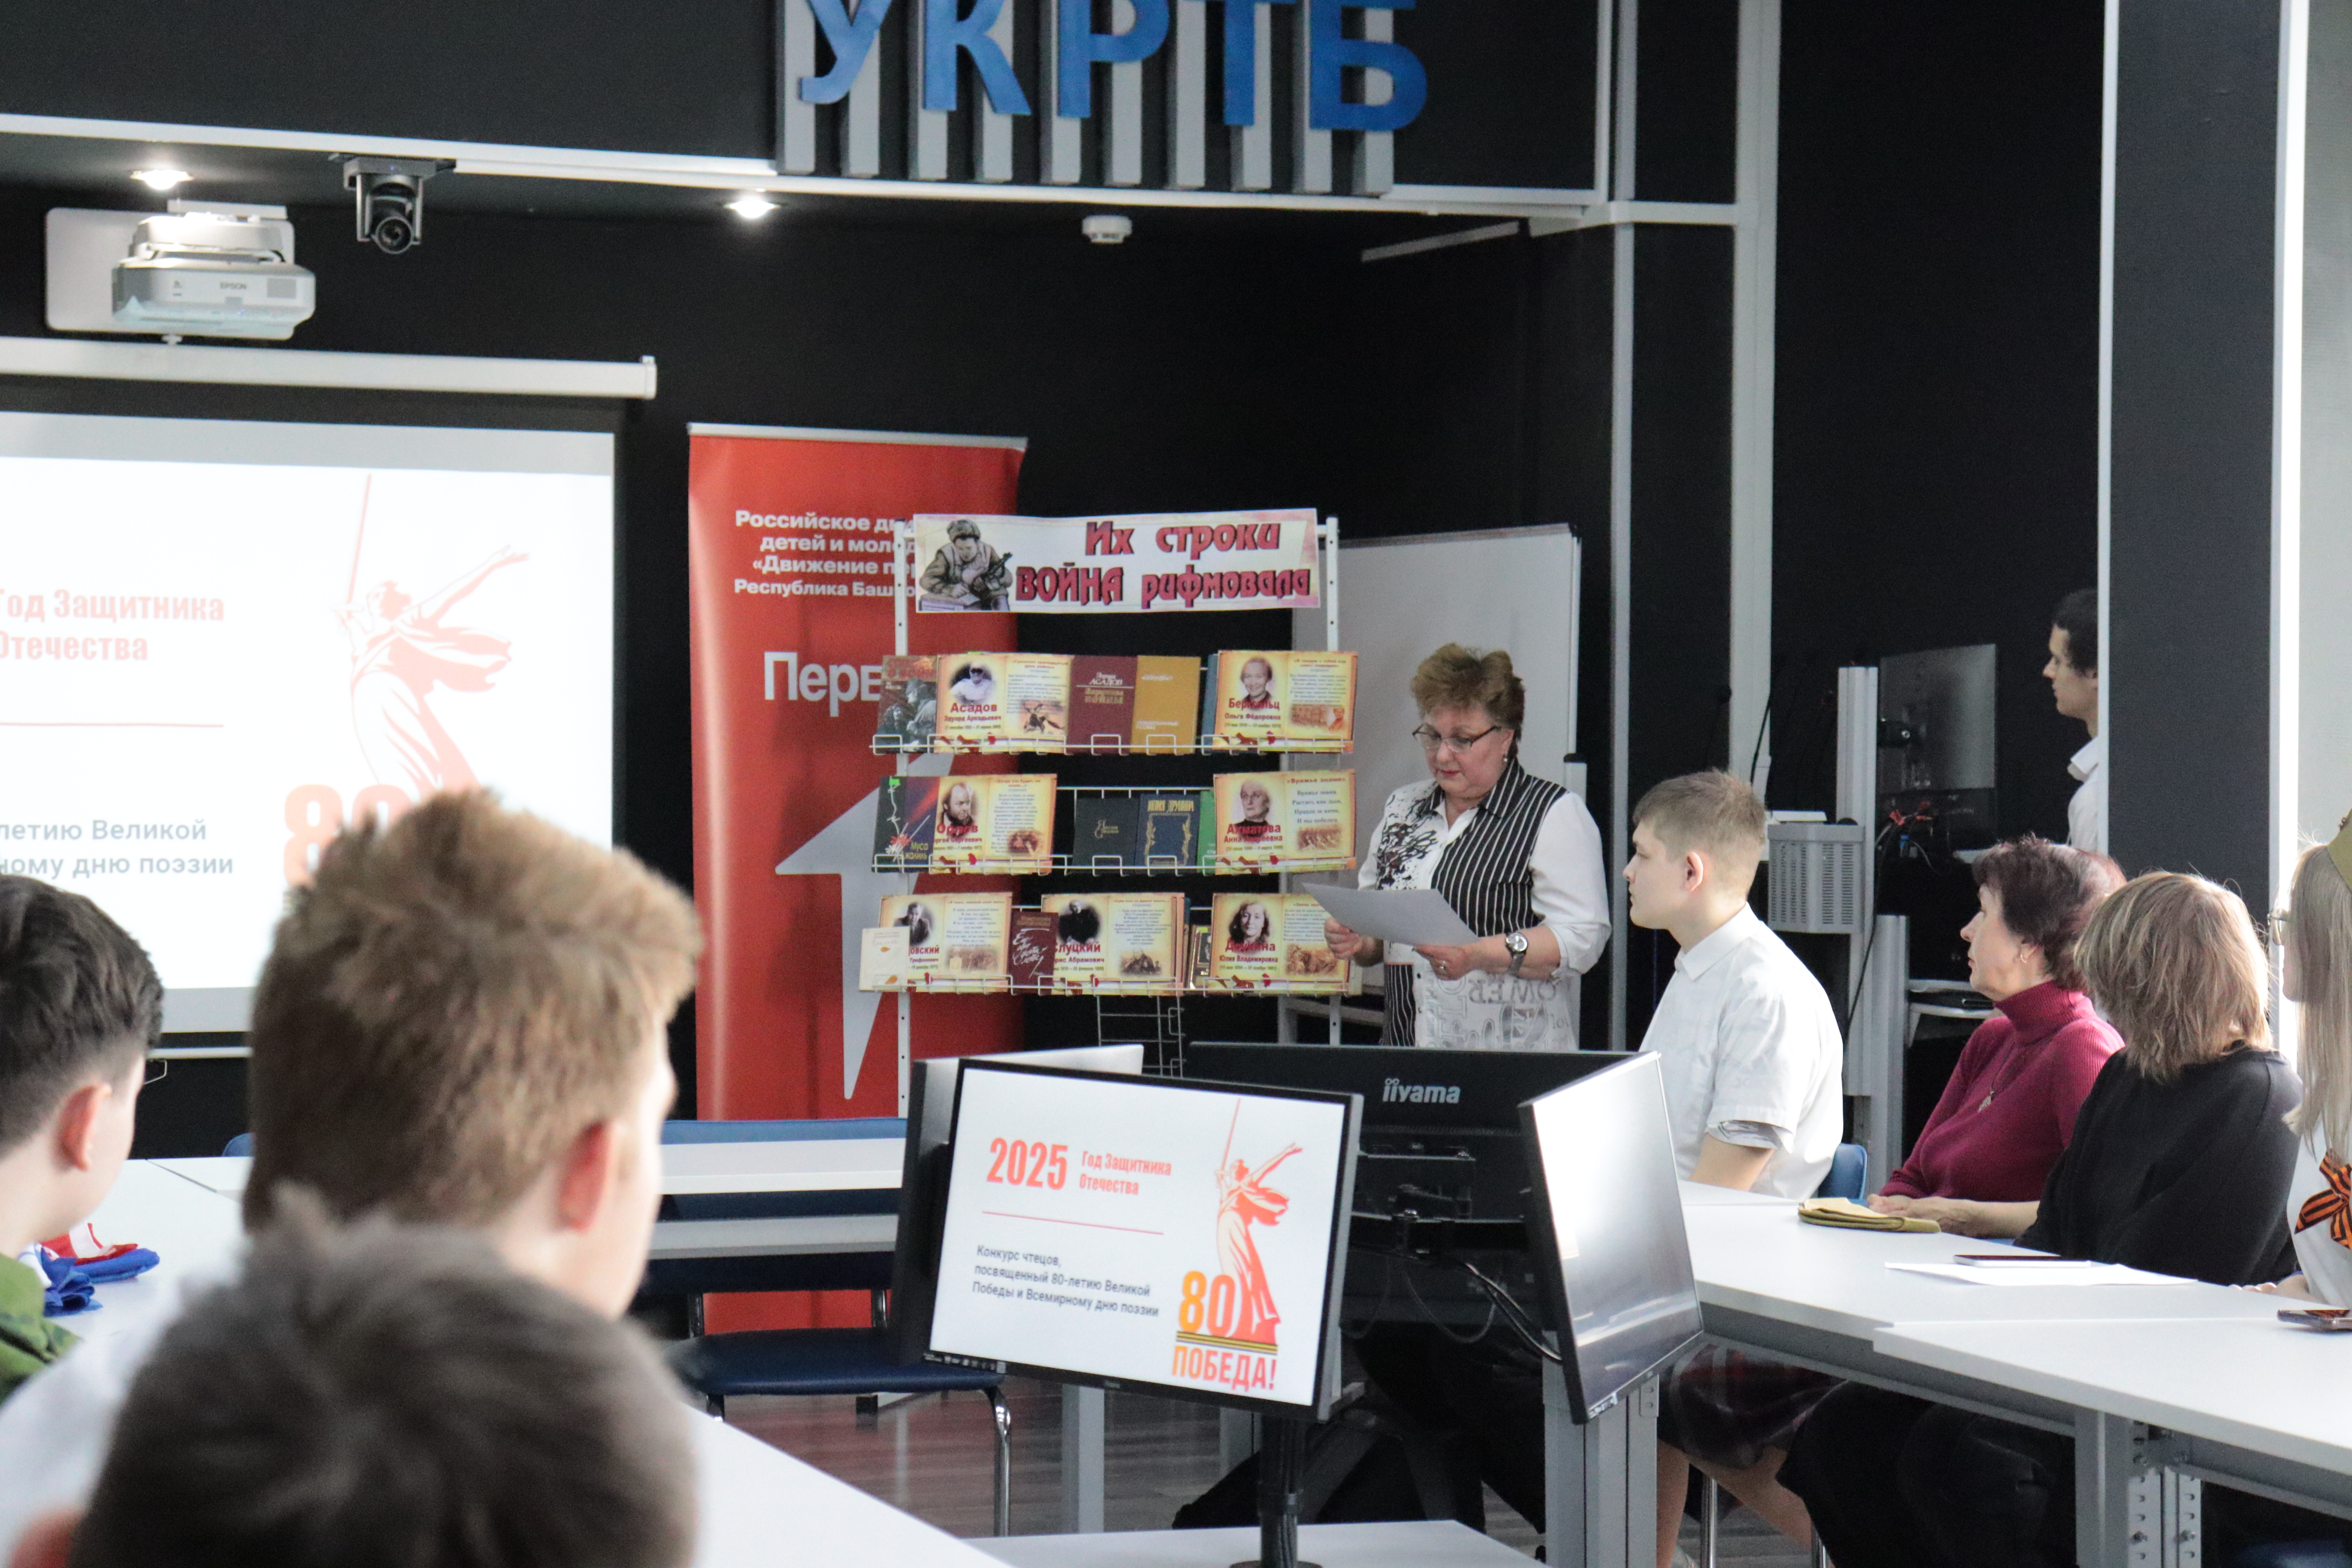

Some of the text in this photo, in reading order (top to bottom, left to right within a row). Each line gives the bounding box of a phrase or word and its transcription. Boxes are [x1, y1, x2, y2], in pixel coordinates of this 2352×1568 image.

[735, 510, 870, 531] Российское
[760, 534, 826, 552] детей
[830, 539, 844, 552] и
[1085, 521, 1281, 560] Их строки
[753, 555, 878, 575] «Движение
[734, 578, 915, 598] Республика Башо
[1142, 564, 1310, 609] рифмовала
[54, 589, 224, 622] Защитника
[950, 702, 998, 714] Асадов
[92, 819, 207, 840] Великой
[1227, 824, 1281, 835] Ахматова
[73, 858, 130, 879] дню
[140, 858, 233, 874] поэзии
[1225, 940, 1276, 953] Друнина
[1237, 955, 1278, 964] Владимировна
[1382, 1078, 1461, 1104] iiyama
[987, 1138, 1172, 1190] 2025 Год Защитника
[1079, 1173, 1140, 1195] Отечества
[976, 1245, 1062, 1269] Конкурс чтецов,
[974, 1264, 1151, 1297] посвященный 80-летию Великой
[972, 1281, 1160, 1318] Победы и Всемирному дню поэзии
[1178, 1270, 1236, 1338] 80
[1171, 1345, 1277, 1392] ПОБЕДА!
